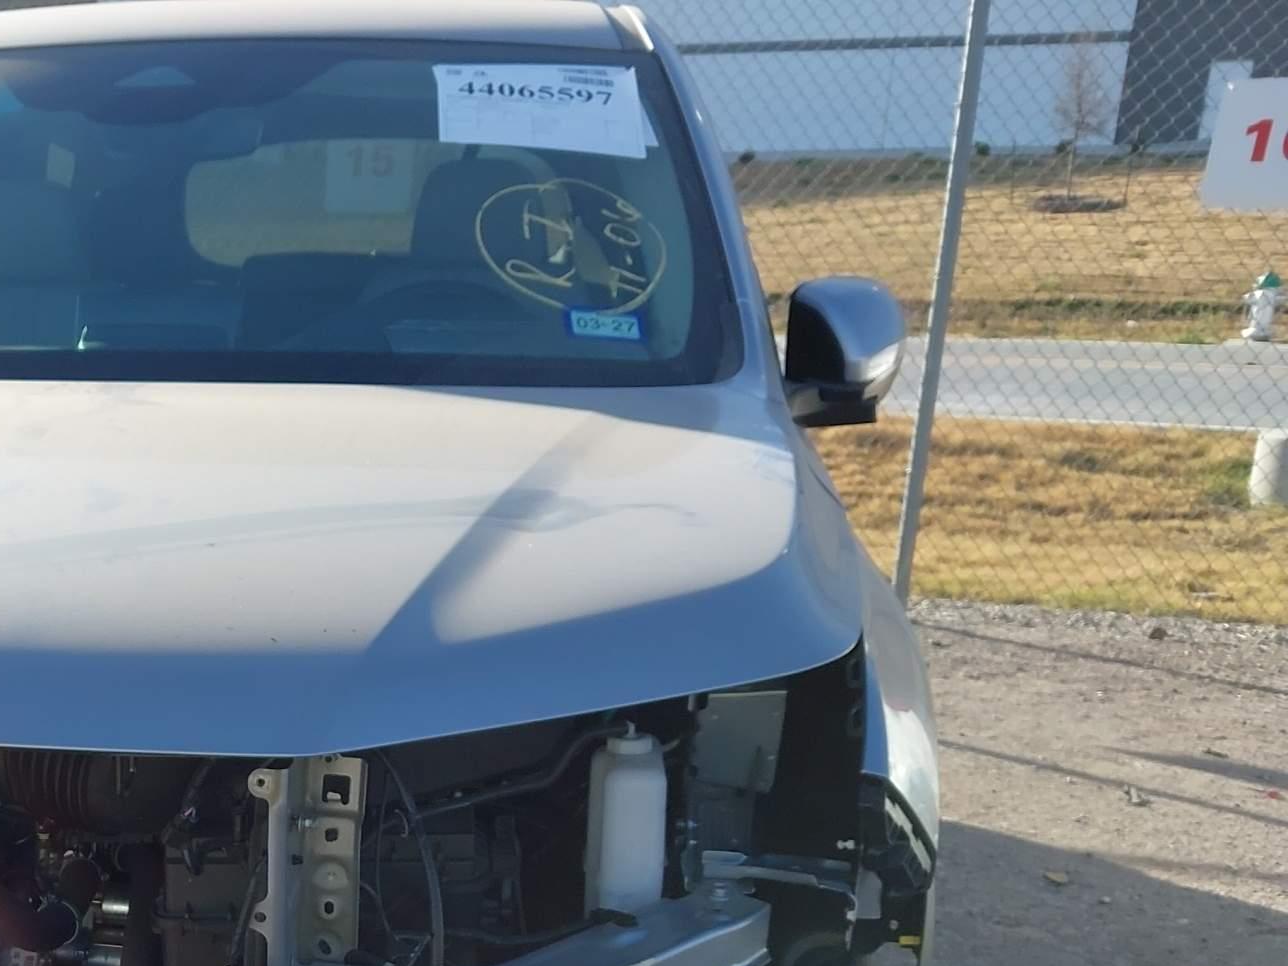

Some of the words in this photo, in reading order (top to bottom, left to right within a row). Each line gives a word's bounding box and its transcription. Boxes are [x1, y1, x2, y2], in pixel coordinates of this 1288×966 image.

[458, 81, 613, 106] 44065597
[1245, 119, 1288, 162] 1
[346, 143, 393, 177] 15
[576, 315, 636, 334] 03-27
